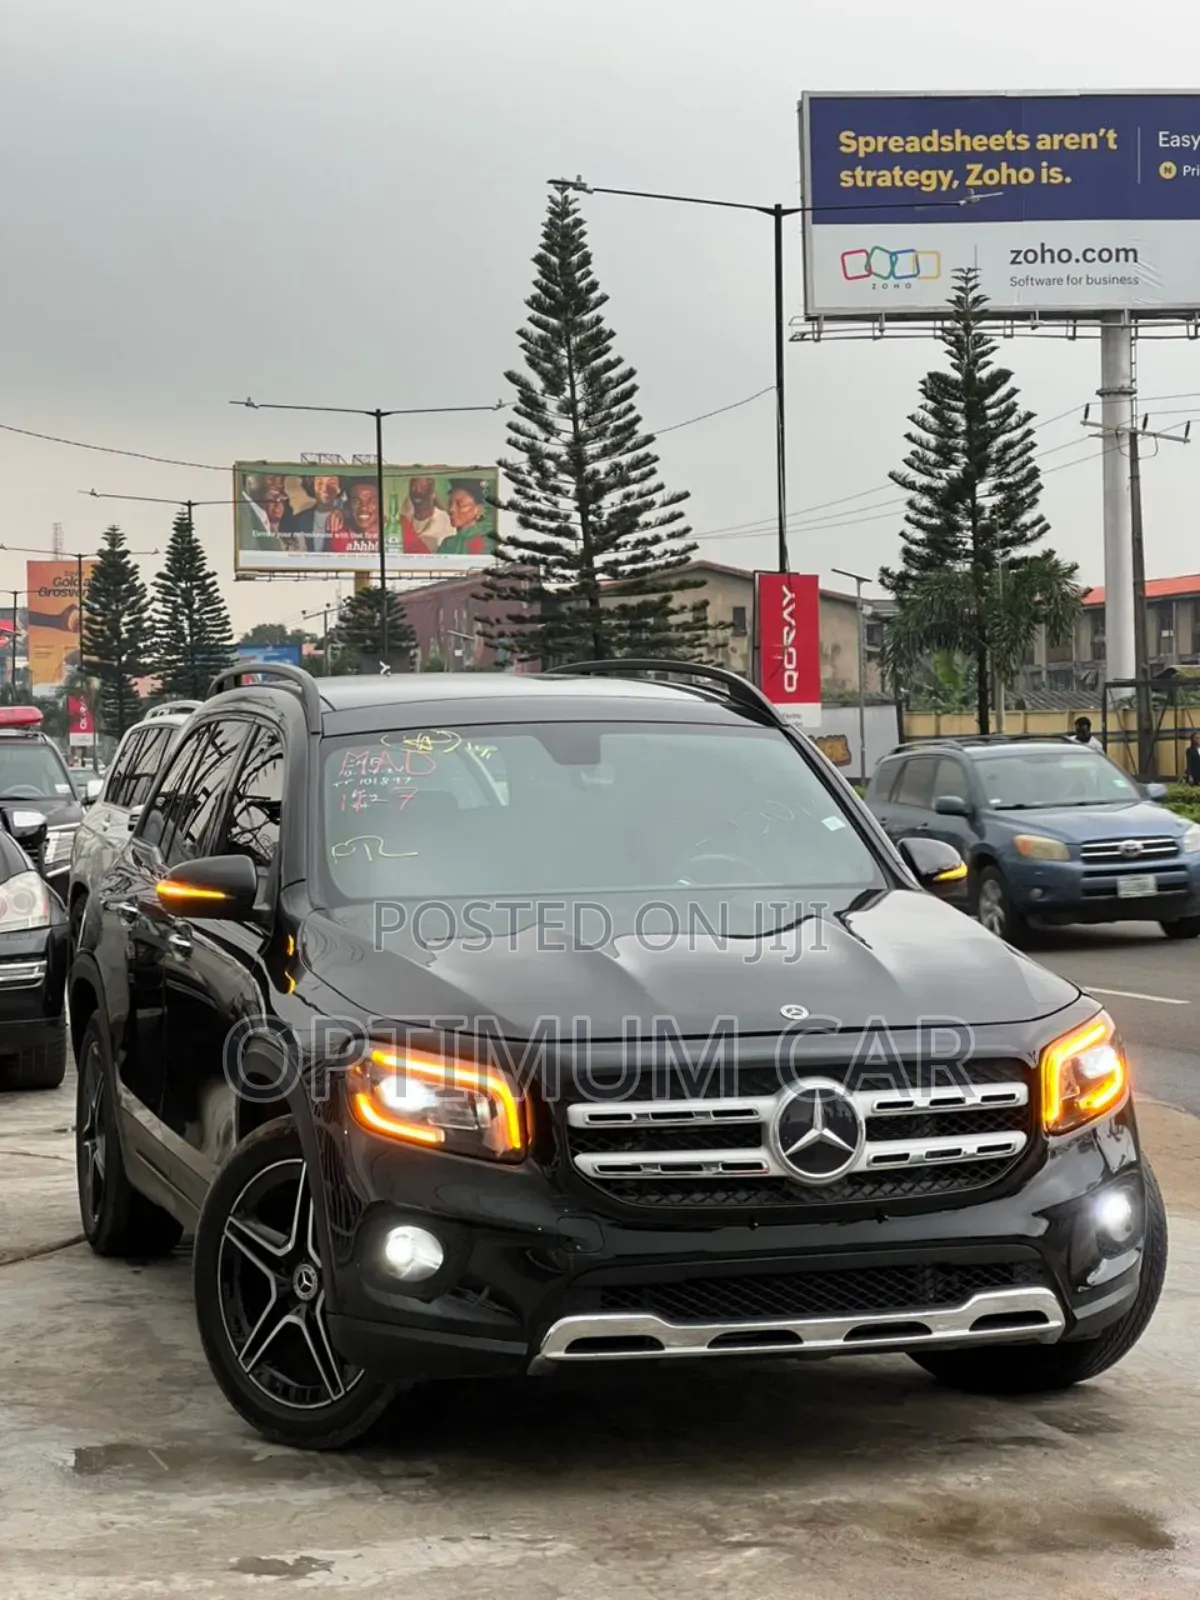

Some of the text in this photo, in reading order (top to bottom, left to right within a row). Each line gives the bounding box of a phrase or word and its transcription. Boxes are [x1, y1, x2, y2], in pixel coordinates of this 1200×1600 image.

[839, 129, 1030, 157] Spreadsheets
[1158, 130, 1200, 150] Easy
[839, 161, 1072, 191] strategy, Zoho is.
[1009, 242, 1138, 265] zoho.com
[1009, 273, 1140, 287] Software for business
[782, 585, 799, 693] QORAY
